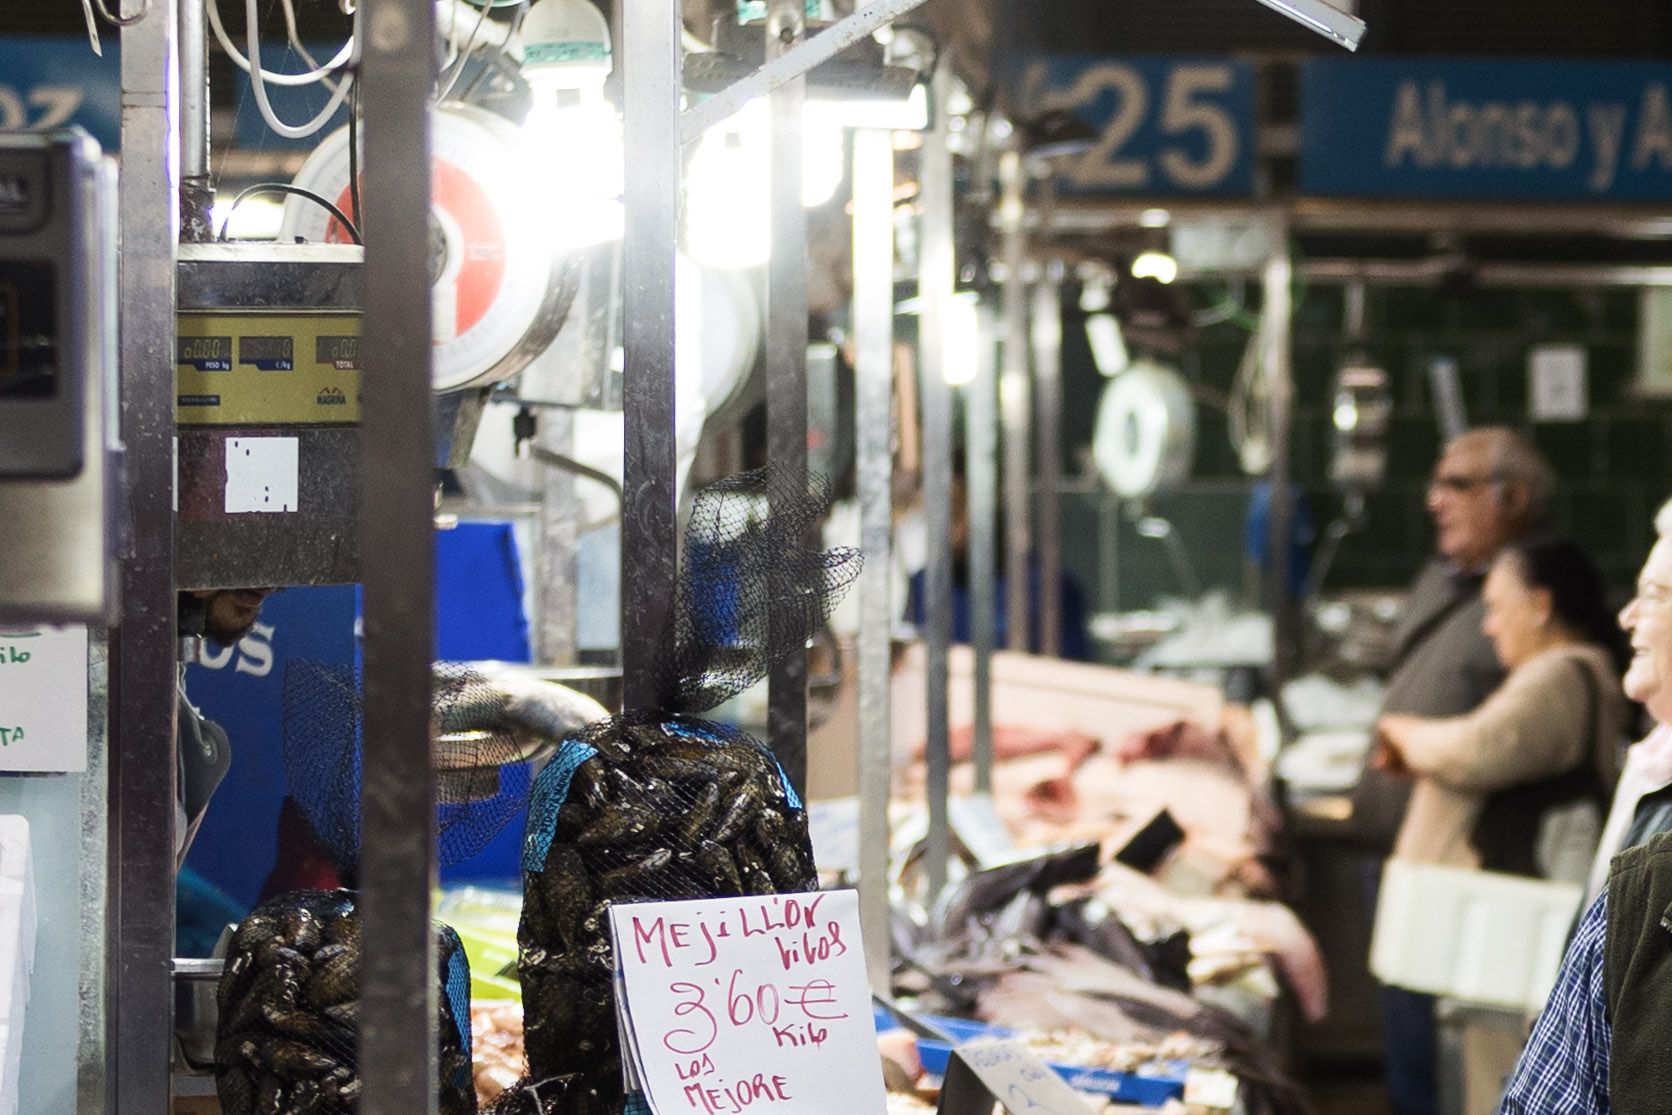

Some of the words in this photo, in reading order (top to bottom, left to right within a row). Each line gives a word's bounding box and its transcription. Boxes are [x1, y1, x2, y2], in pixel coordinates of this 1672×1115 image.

[1066, 63, 1238, 188] 25
[1387, 80, 1581, 169] Alonso
[1588, 102, 1626, 192] y
